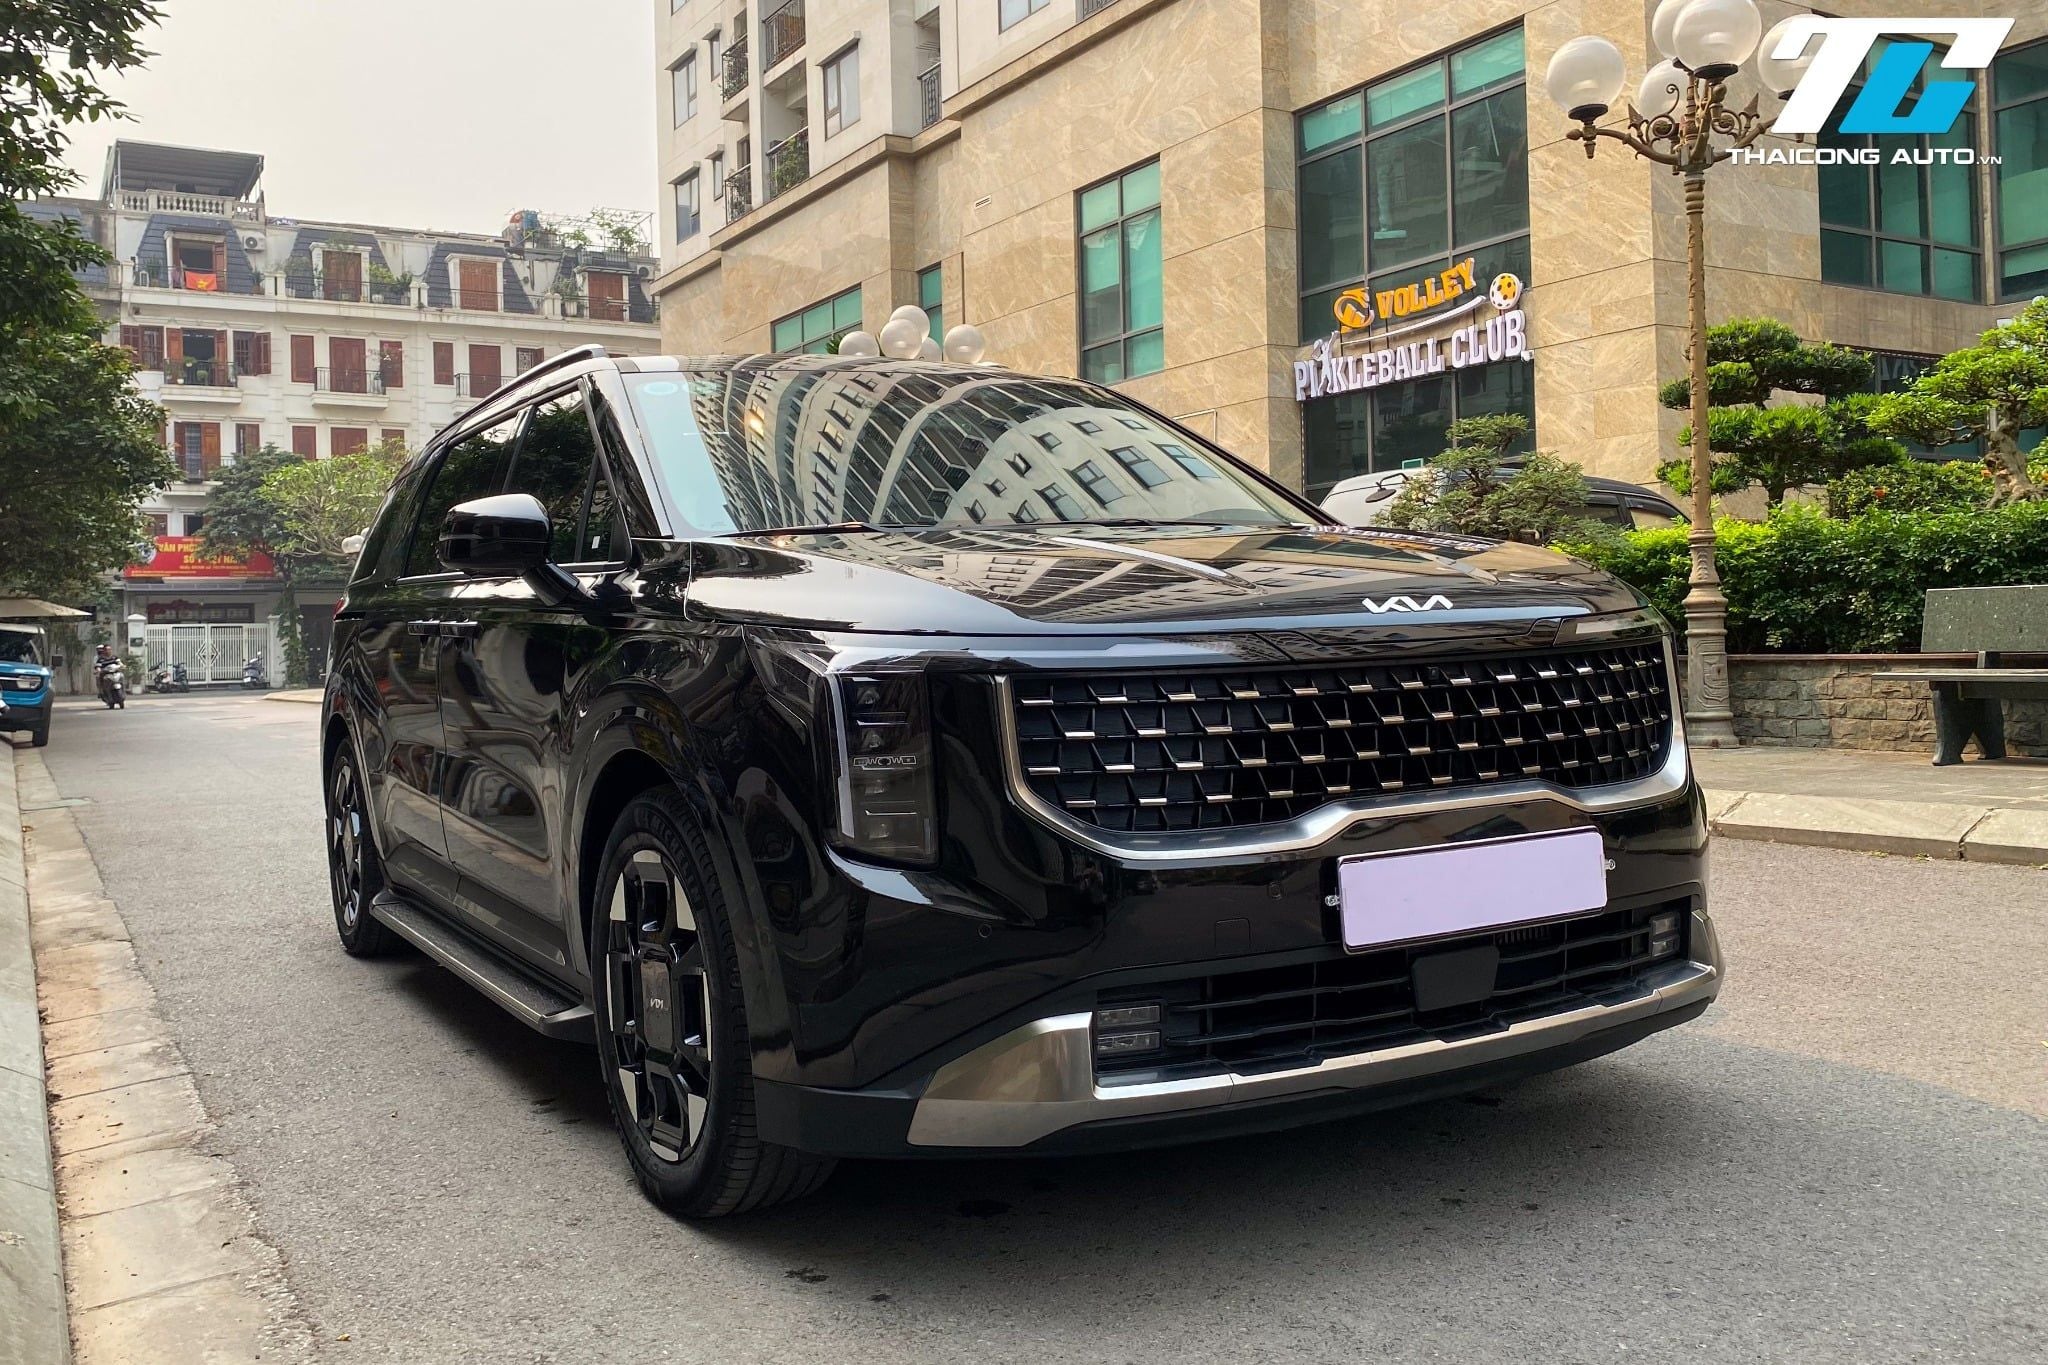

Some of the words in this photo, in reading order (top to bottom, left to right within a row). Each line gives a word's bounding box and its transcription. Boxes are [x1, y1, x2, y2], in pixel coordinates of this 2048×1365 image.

[1376, 257, 1477, 319] VOLLEY
[1293, 335, 1446, 401] PIKLEBALL
[1451, 309, 1526, 369] CLUB
[1361, 594, 1454, 614] KIA
